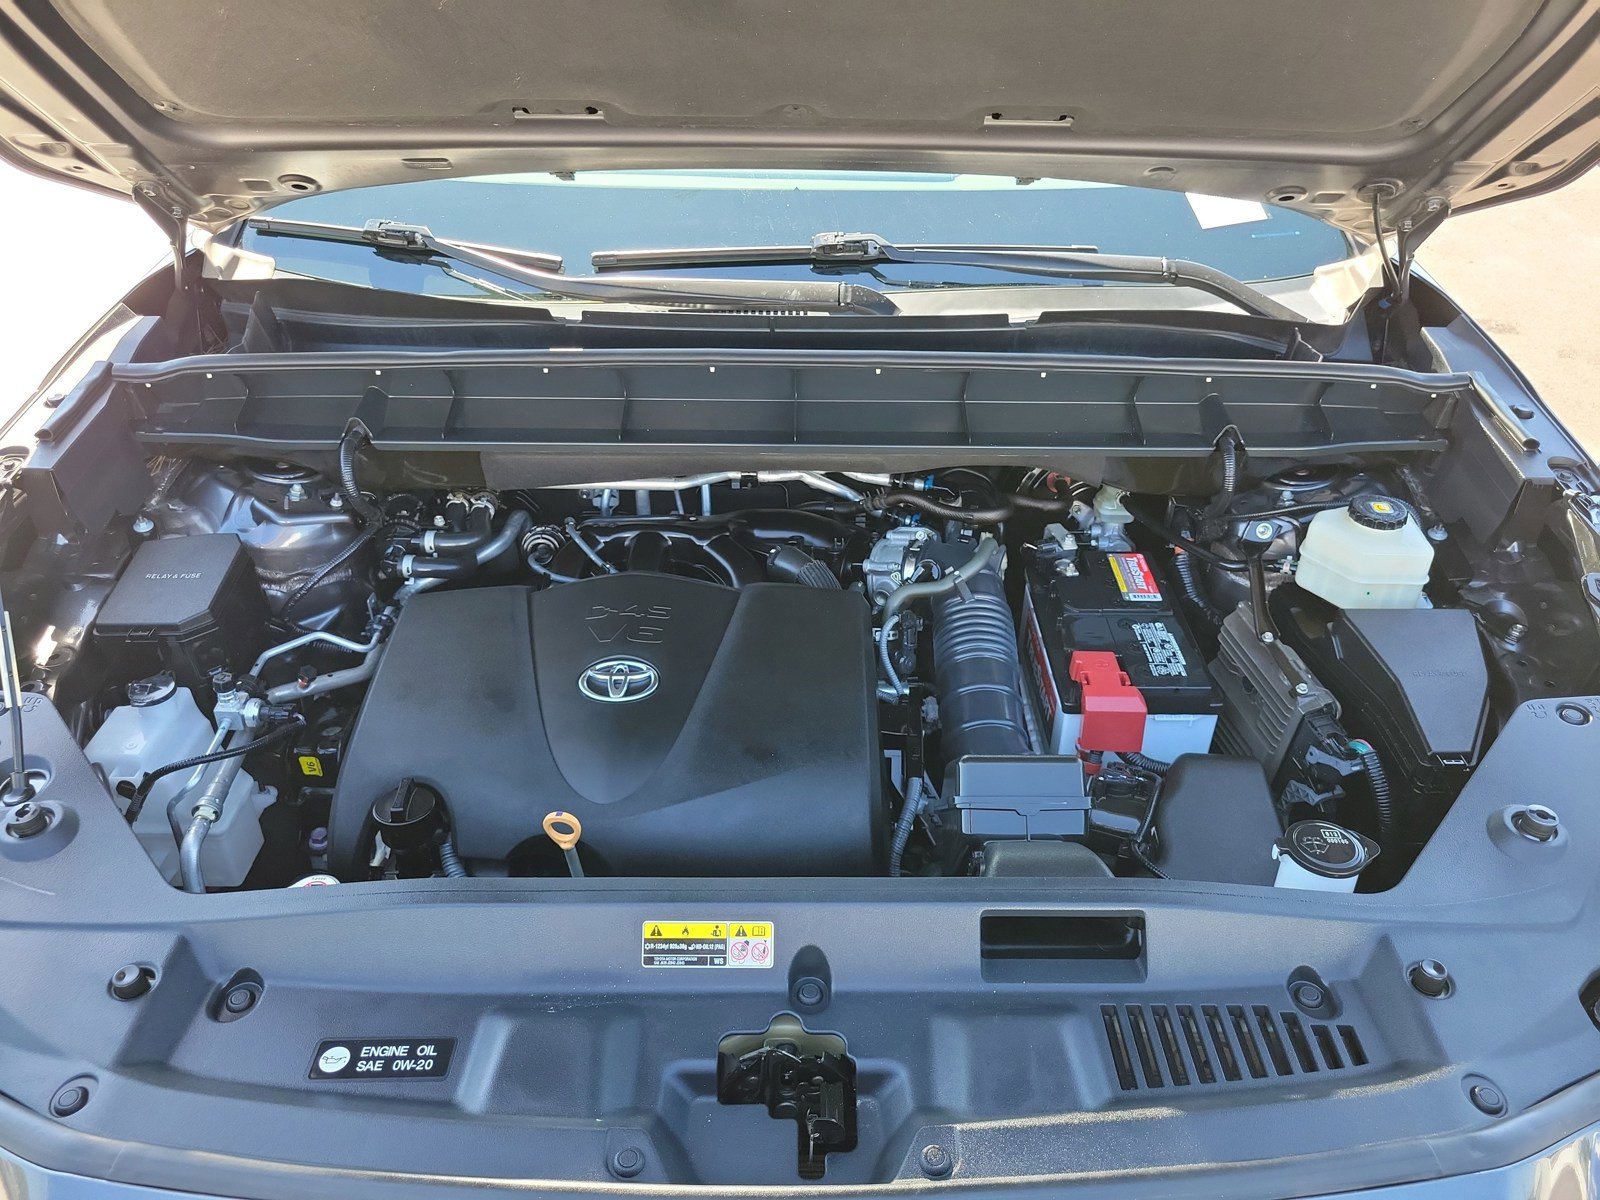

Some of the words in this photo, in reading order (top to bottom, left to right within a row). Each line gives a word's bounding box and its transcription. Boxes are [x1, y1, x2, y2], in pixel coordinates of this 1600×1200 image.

[587, 623, 664, 644] V6
[360, 1045, 409, 1057] ENGINE
[416, 1045, 437, 1056] OIL
[356, 1060, 384, 1072] SAE
[392, 1059, 433, 1071] 0W-20
